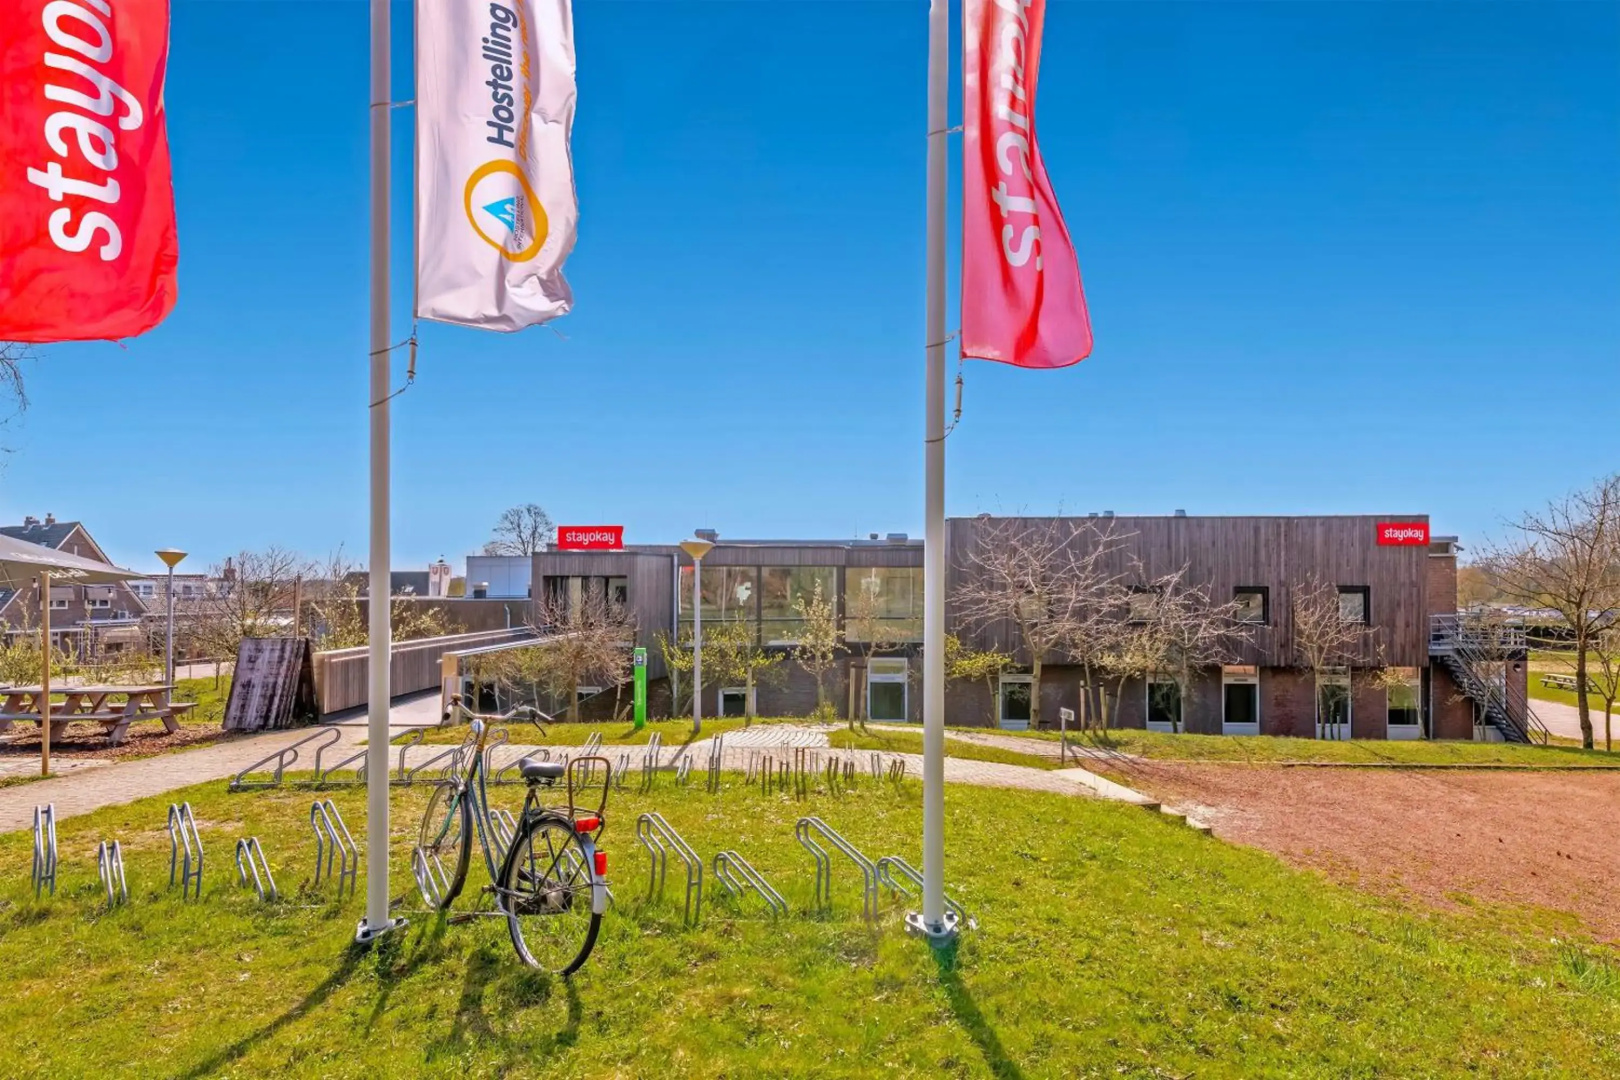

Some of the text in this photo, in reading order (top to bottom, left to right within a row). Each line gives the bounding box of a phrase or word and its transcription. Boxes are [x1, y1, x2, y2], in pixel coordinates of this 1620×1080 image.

[482, 3, 518, 149] Hostelling
[27, 0, 143, 261] stayo
[566, 531, 615, 545] stayokay
[1384, 528, 1424, 541] stayokay
